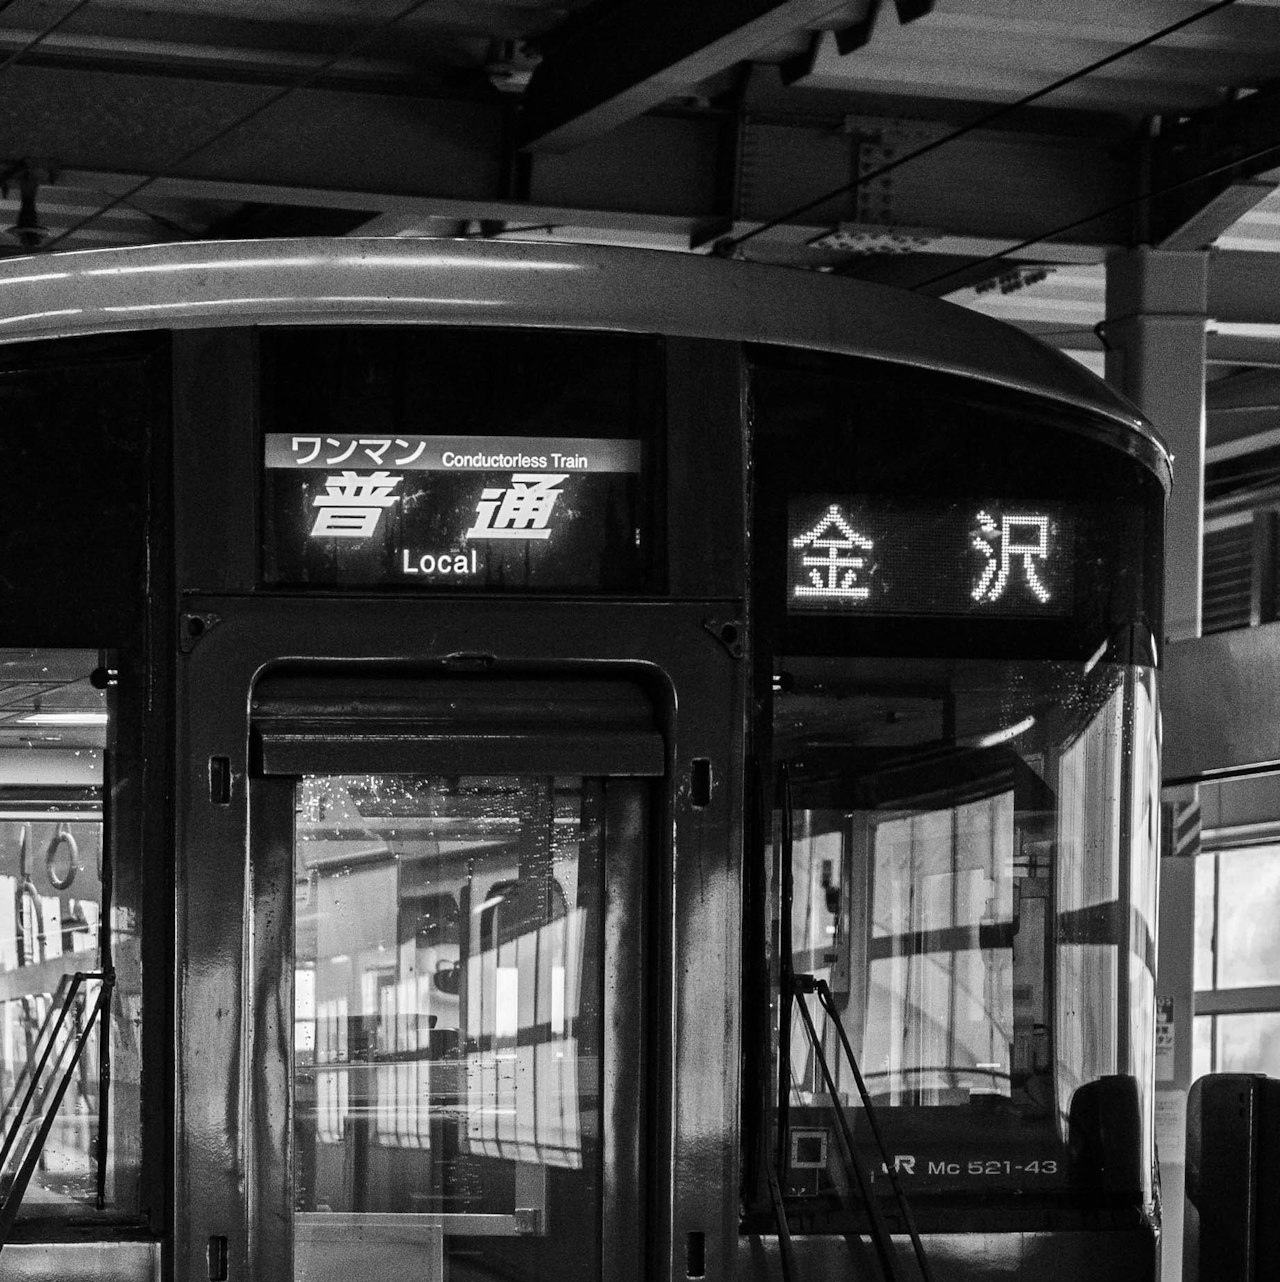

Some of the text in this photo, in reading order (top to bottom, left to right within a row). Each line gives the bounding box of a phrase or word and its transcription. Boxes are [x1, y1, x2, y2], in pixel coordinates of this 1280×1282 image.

[292, 437, 588, 469] ワンマン Conductorless Train
[310, 471, 569, 540] 普通
[402, 549, 477, 574] Local
[793, 504, 1051, 603] 金沢
[928, 1161, 960, 1176] Mc
[967, 1160, 1059, 1176] 521-43
